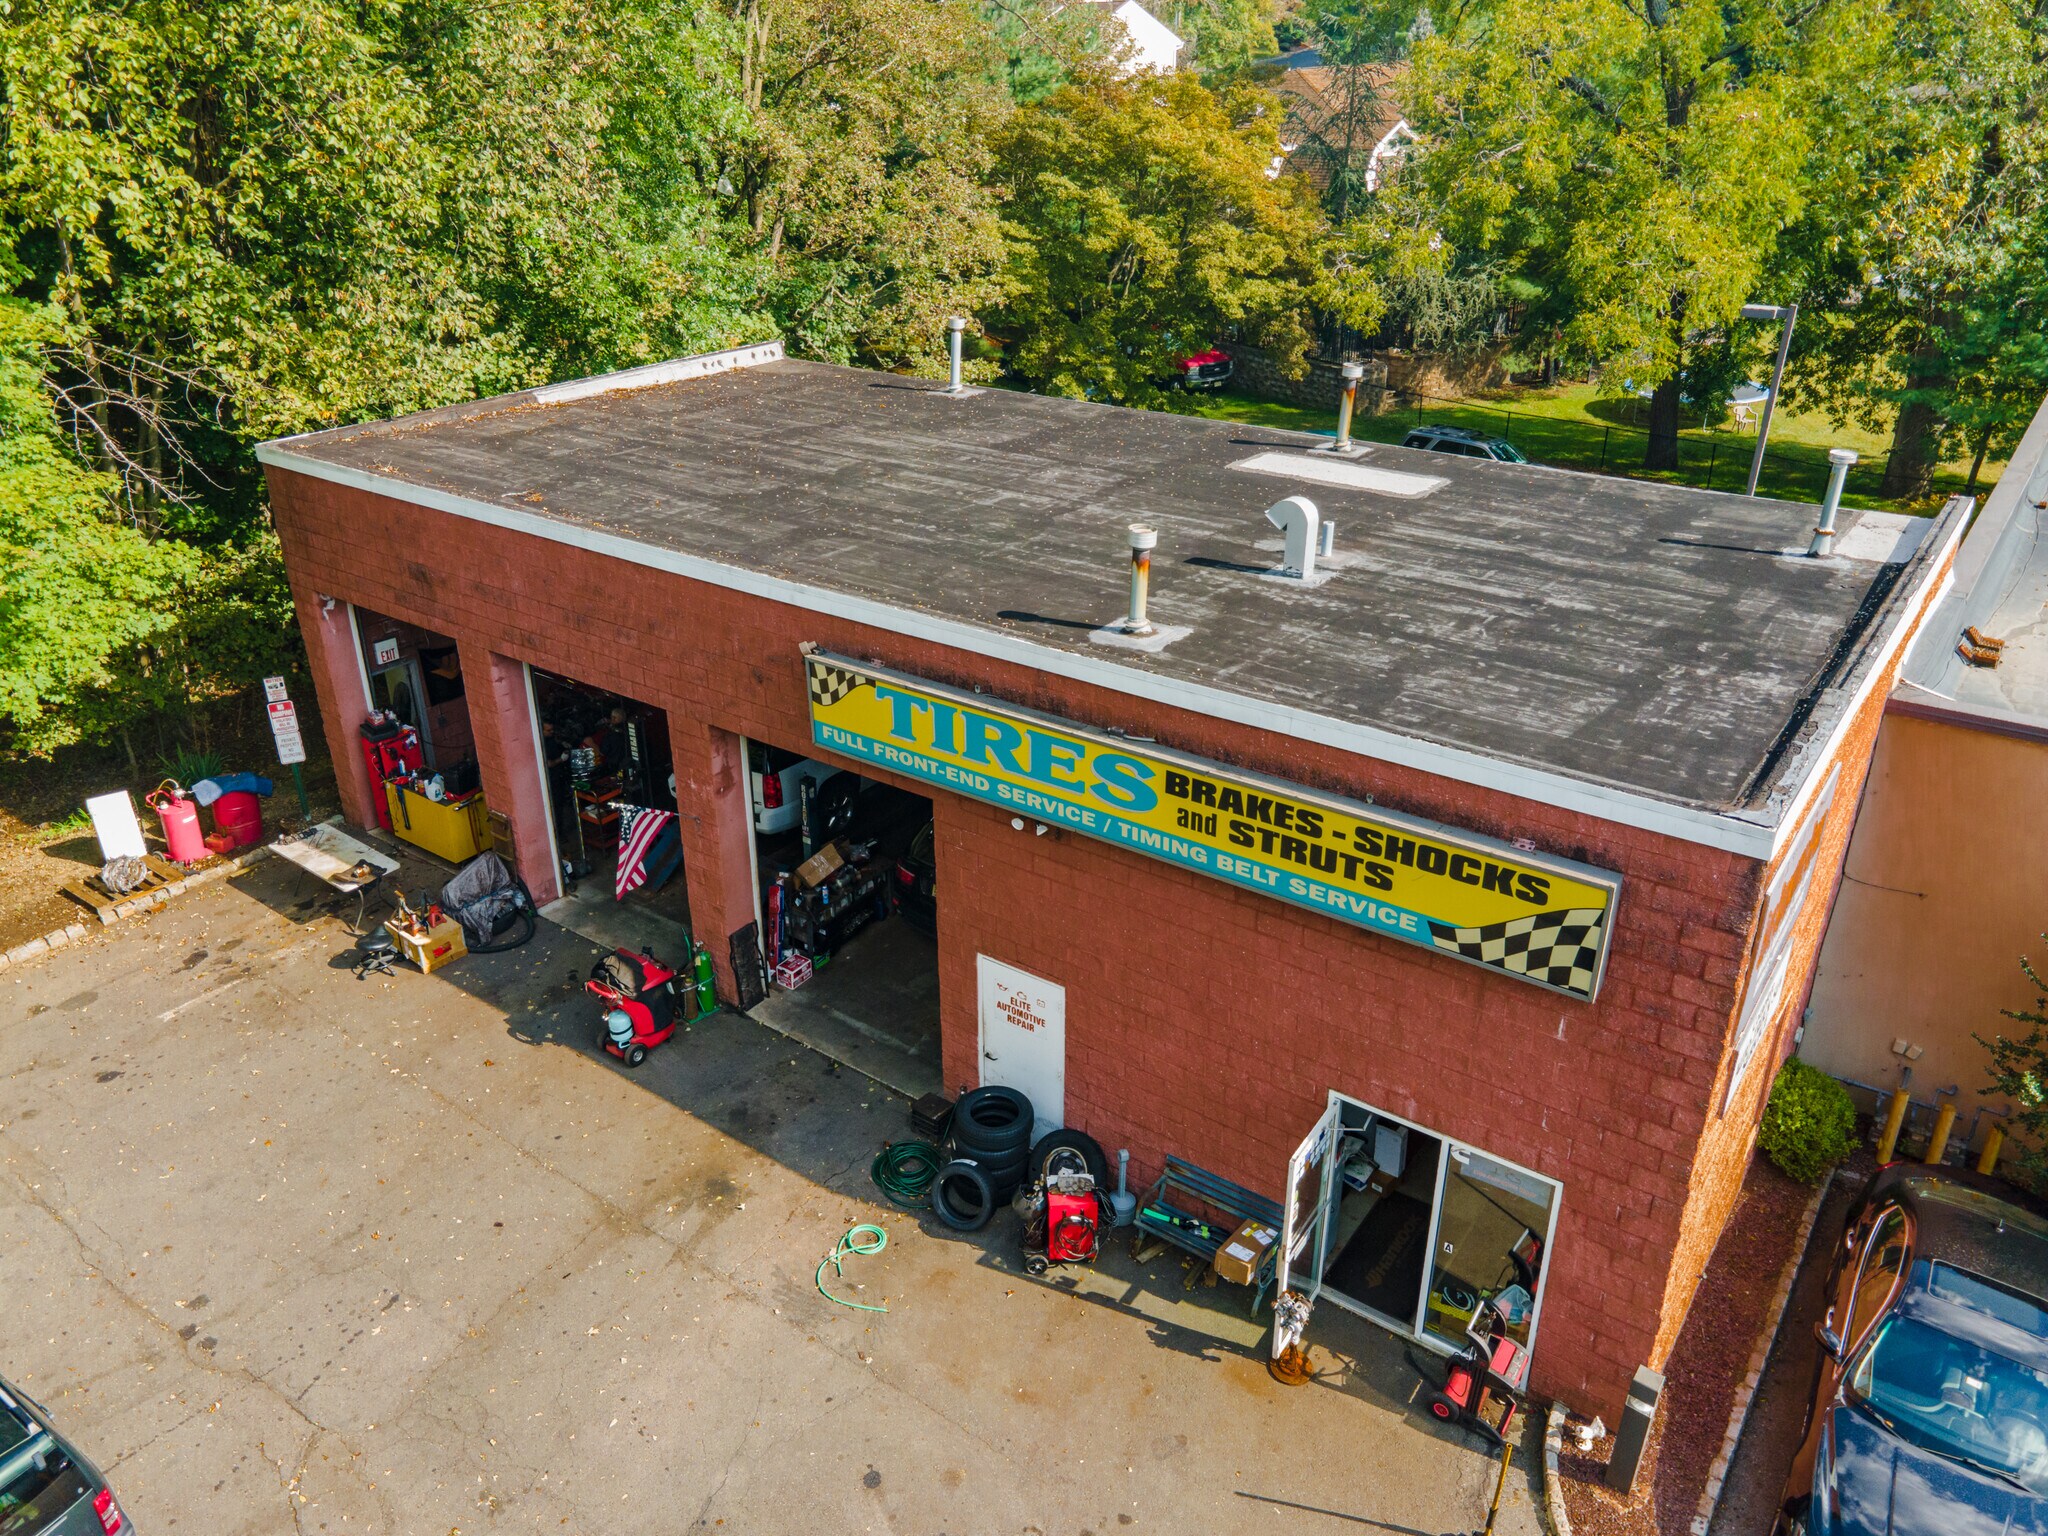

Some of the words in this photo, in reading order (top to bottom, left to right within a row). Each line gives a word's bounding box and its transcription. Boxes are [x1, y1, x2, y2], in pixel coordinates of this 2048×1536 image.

[380, 647, 397, 663] EXIT
[875, 685, 1159, 813] TIRES
[822, 725, 869, 753] FULL
[873, 742, 990, 792] FRONT-END
[996, 783, 1096, 829] SERVICE
[1103, 817, 1112, 834] /
[1118, 821, 1208, 864] TIMING
[1216, 853, 1280, 886] BELT
[1288, 877, 1419, 933] SERVICE
[1164, 770, 1324, 839] BRAKES
[1354, 825, 1551, 906] SHOCKS
[1177, 806, 1218, 838] and
[1228, 820, 1395, 892] STRUTS
[996, 1001, 1046, 1028] AUTOMOTIVE
[1007, 1014, 1035, 1033] REPAIR
[1010, 996, 1031, 1012] ELITE
